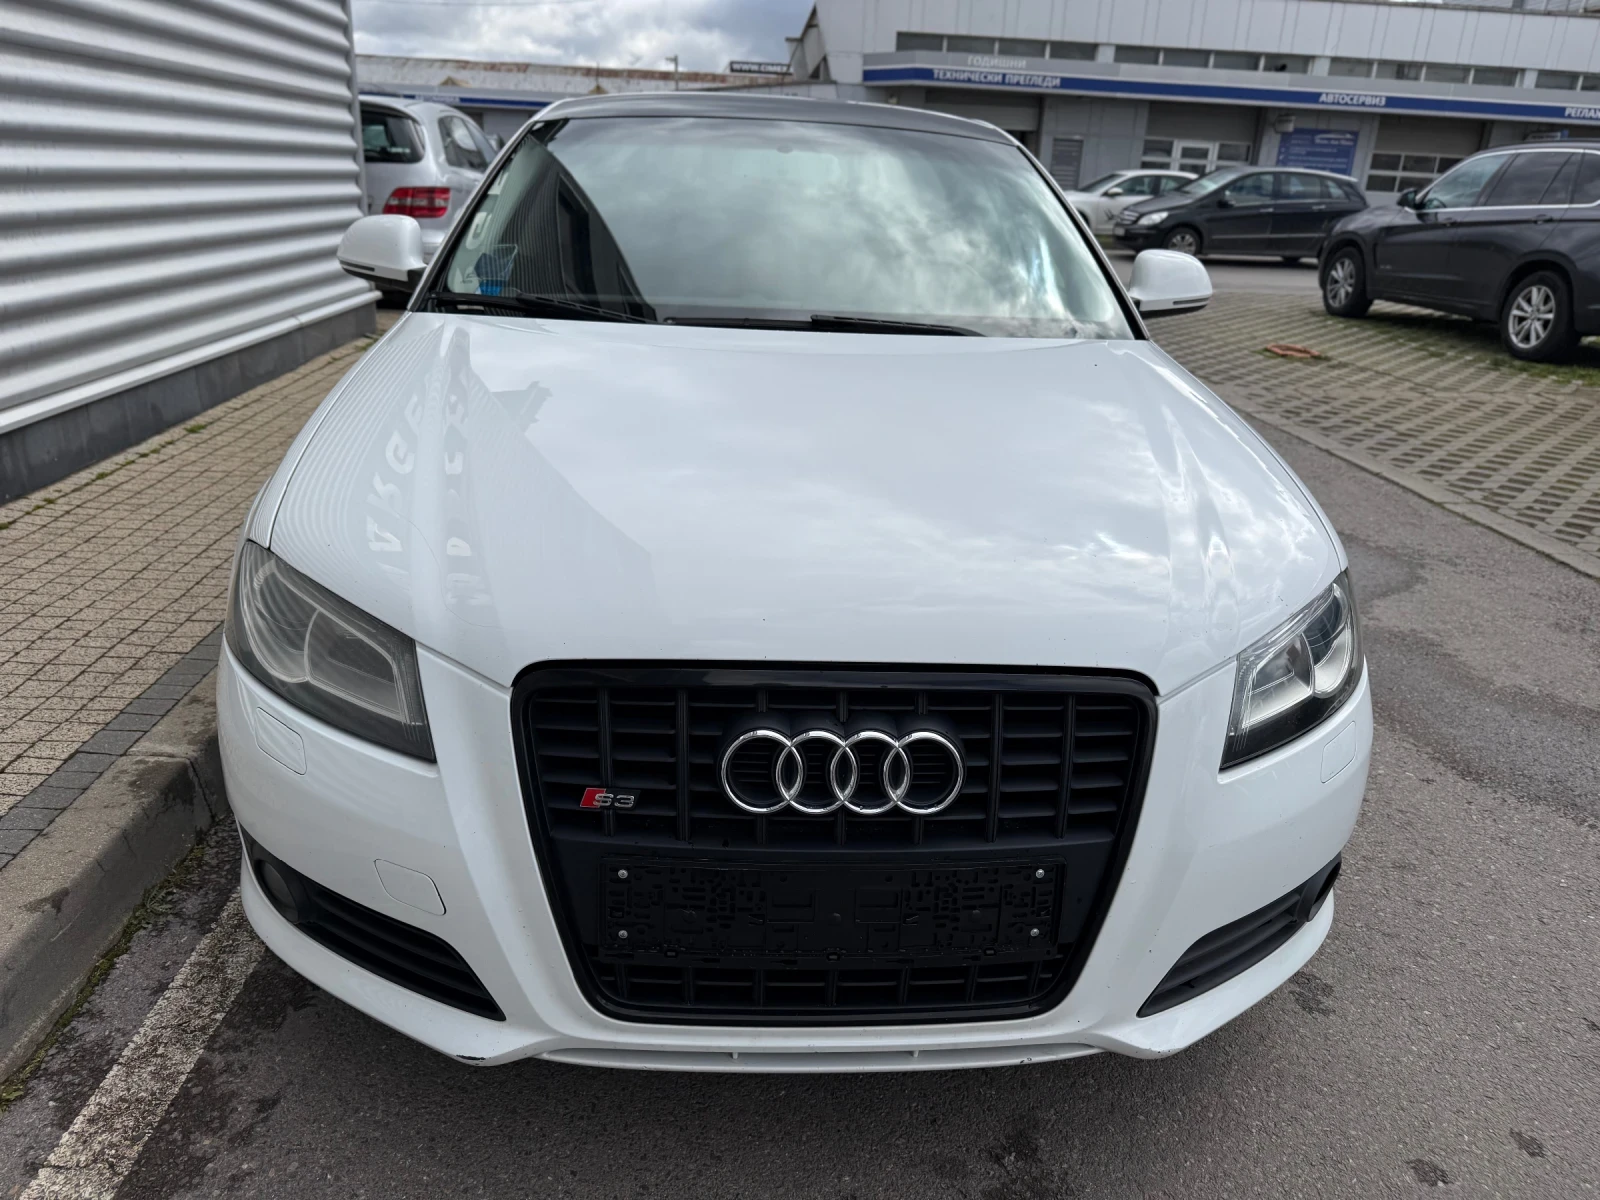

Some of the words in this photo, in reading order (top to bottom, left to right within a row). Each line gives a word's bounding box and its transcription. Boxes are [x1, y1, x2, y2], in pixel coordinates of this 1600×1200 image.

[967, 55, 1027, 69] ГОДИШНИ
[932, 69, 1002, 83] ТЕХНИЧЕСКИ
[1005, 74, 1061, 87] ПРЕГЛЕДИ
[1319, 93, 1386, 107] АВТОСЕРВИЗ
[593, 793, 635, 808] S3
